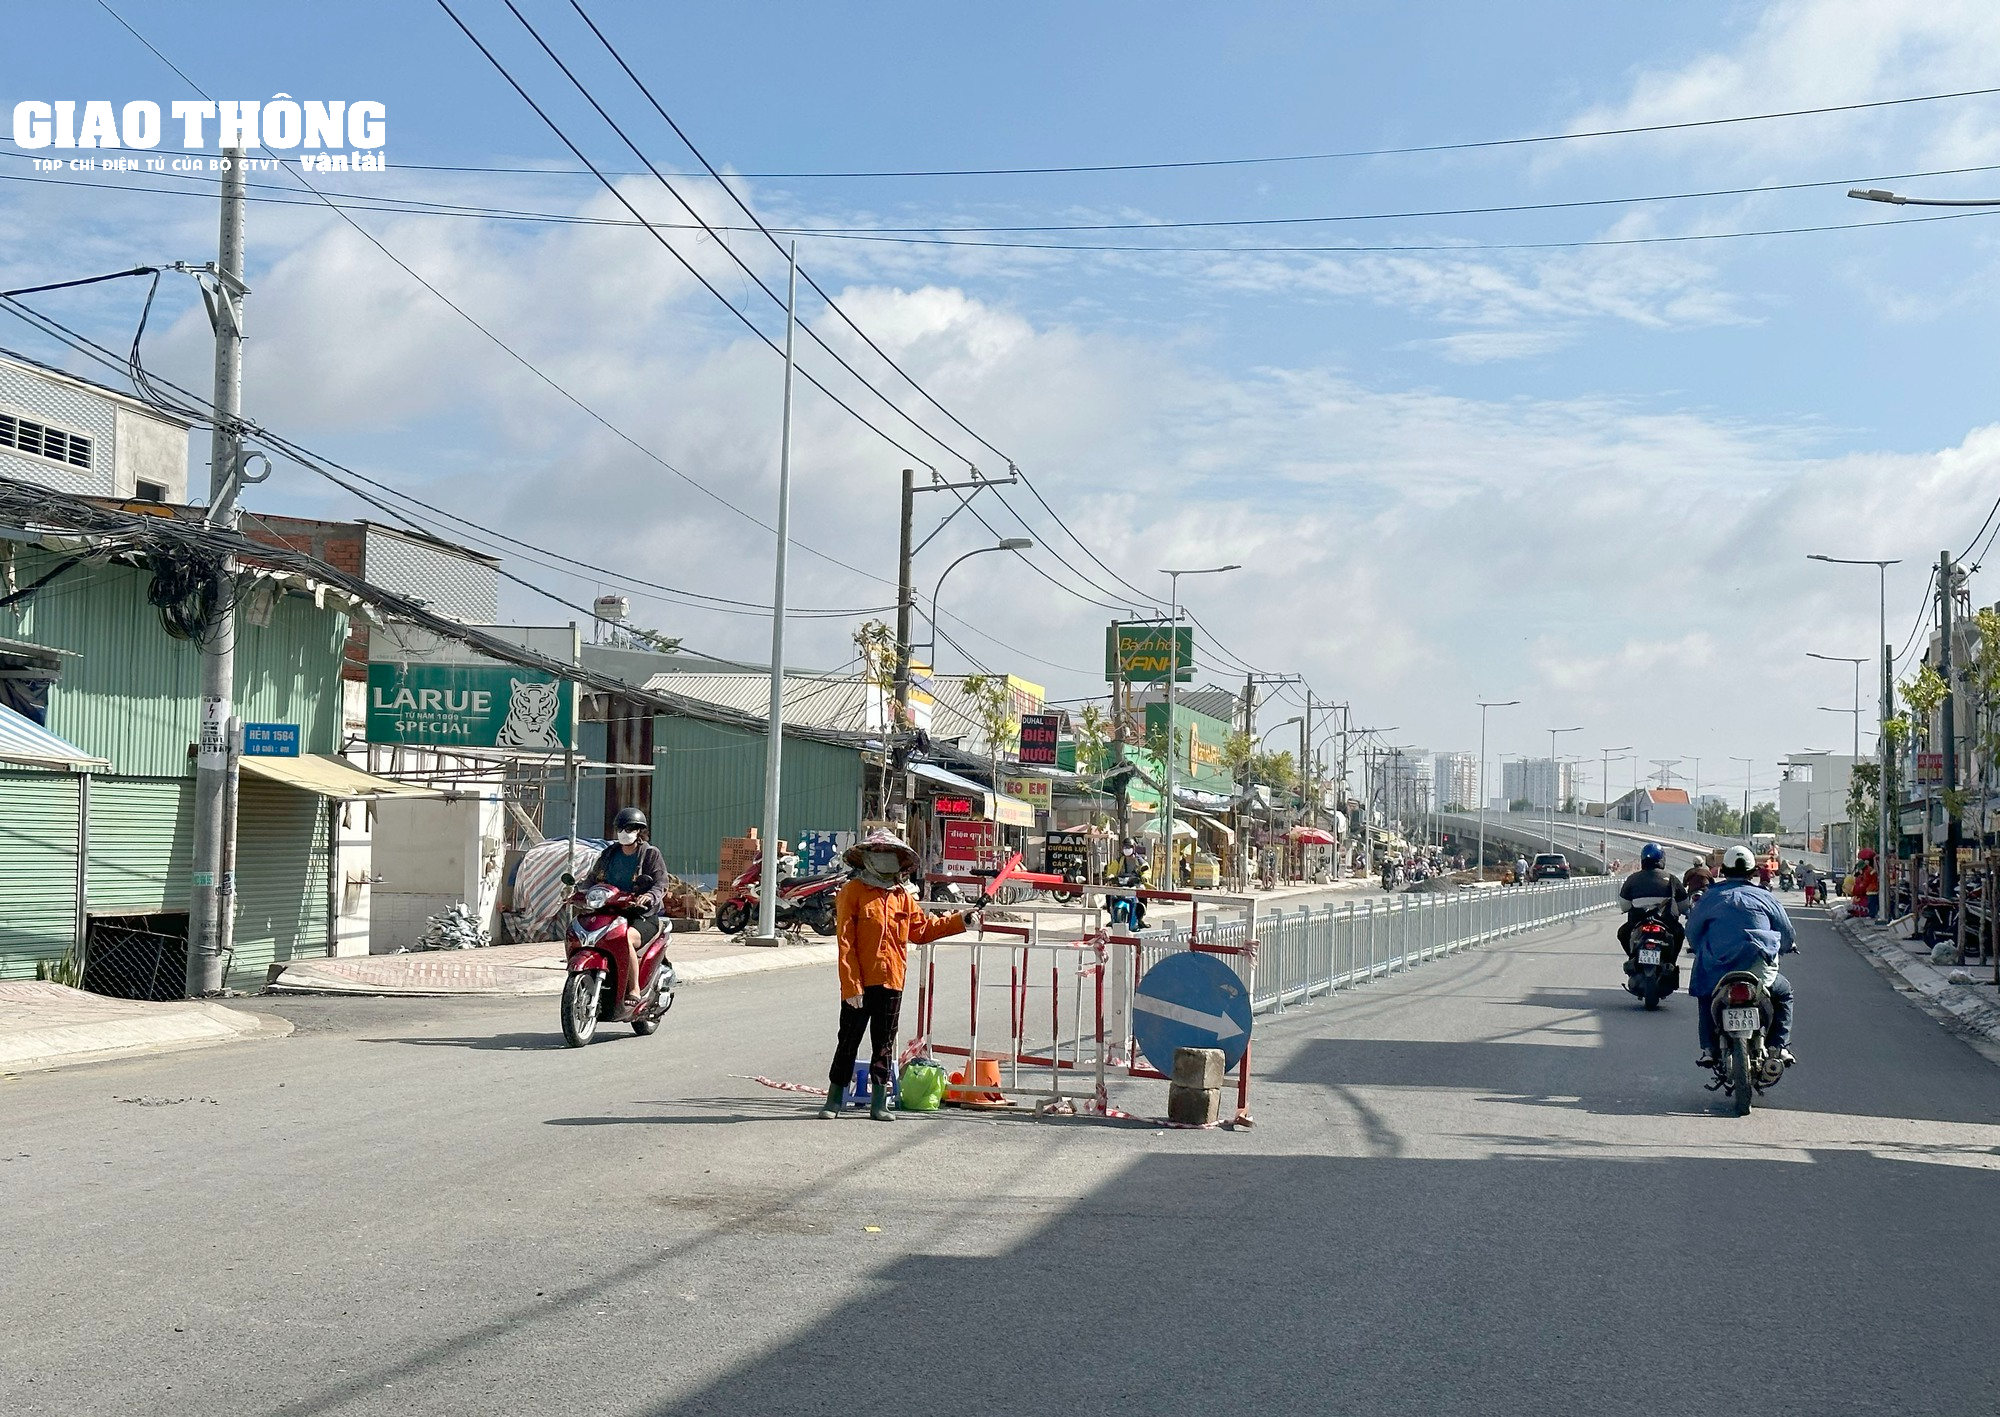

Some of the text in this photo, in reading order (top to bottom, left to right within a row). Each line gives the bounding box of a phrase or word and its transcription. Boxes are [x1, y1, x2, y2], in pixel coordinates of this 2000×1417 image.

[1120, 638, 1153, 651] Bách
[1120, 656, 1180, 671] XANH
[373, 687, 492, 713] LARUE
[249, 727, 270, 741] HẺM
[394, 721, 471, 735] SPECIAL
[1022, 728, 1055, 745] ĐIỆN
[1020, 747, 1056, 761] NƯỚC
[1028, 782, 1047, 795] EM
[1047, 844, 1073, 852] CƯỜNG
